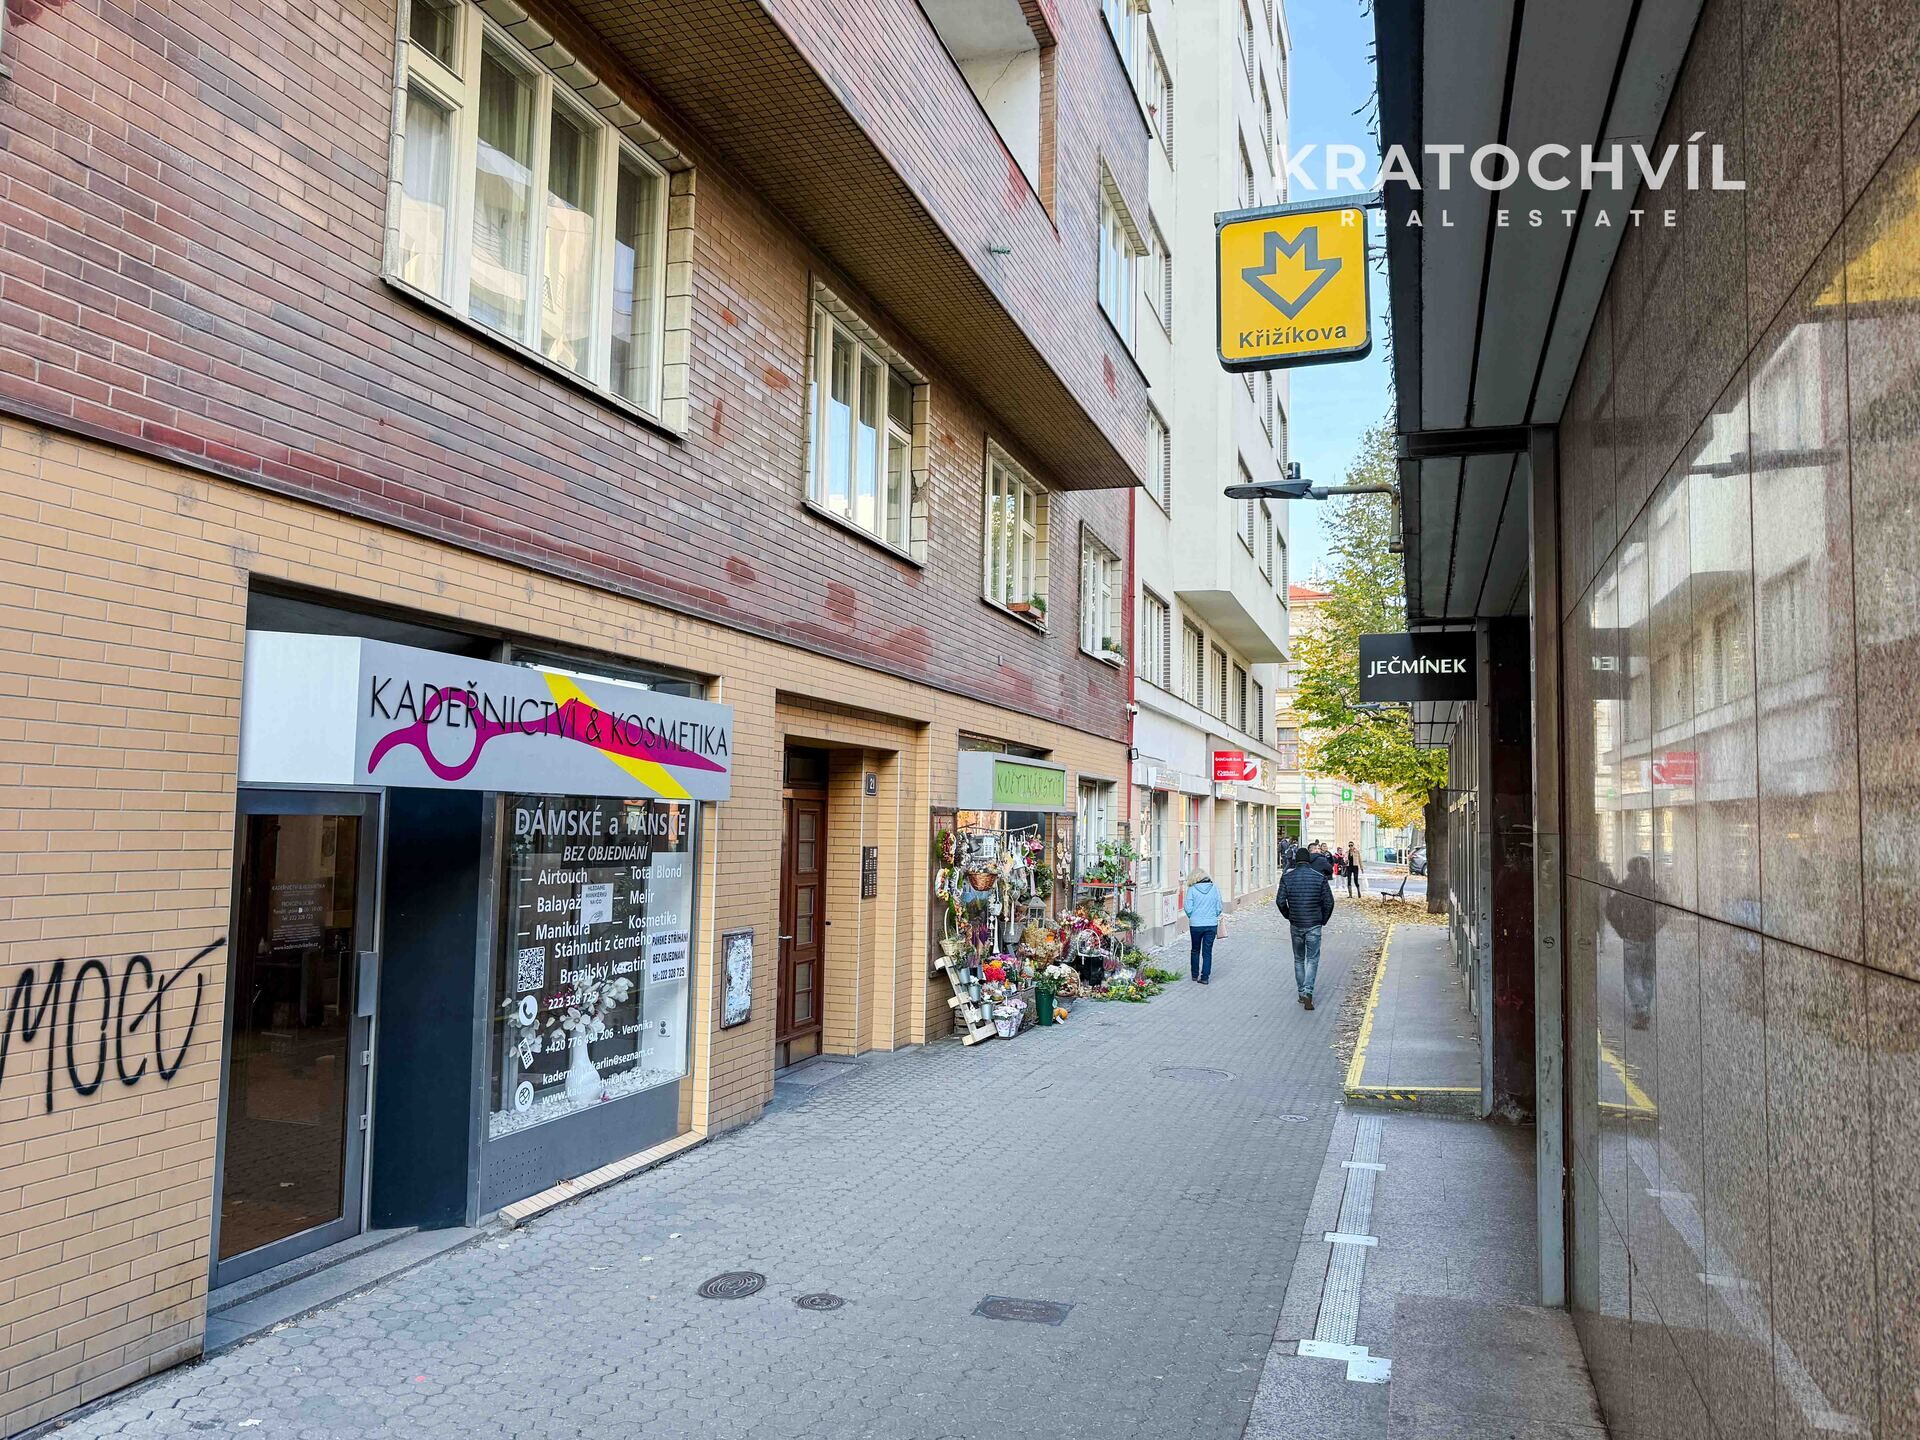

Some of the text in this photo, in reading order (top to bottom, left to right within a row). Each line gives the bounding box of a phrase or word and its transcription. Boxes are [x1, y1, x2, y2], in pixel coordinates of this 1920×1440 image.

[1239, 325, 1347, 349] Křižíkova
[1367, 655, 1467, 678] JEČMÍNEK
[370, 675, 729, 756] KADEŘNICTVÍ & KOSMETIKA
[515, 801, 603, 836] DÁMSKÉ
[609, 816, 619, 836] a
[563, 842, 649, 862] BEZ OBJEDNÁNÍ
[537, 867, 588, 885] Airtouch
[630, 863, 682, 880] Total Blond
[537, 894, 582, 915] Balayaž
[535, 919, 591, 940] Manikúra
[628, 910, 677, 930] Kosmetika
[554, 933, 653, 958] Stáhnutí z černého
[560, 957, 646, 984] Brazilský keratin
[548, 991, 598, 1010] 222 328 725
[545, 1040, 566, 1054] +420
[567, 1035, 583, 1049] 776
[600, 1028, 614, 1041] 206
[622, 1019, 653, 1036] Veronika
